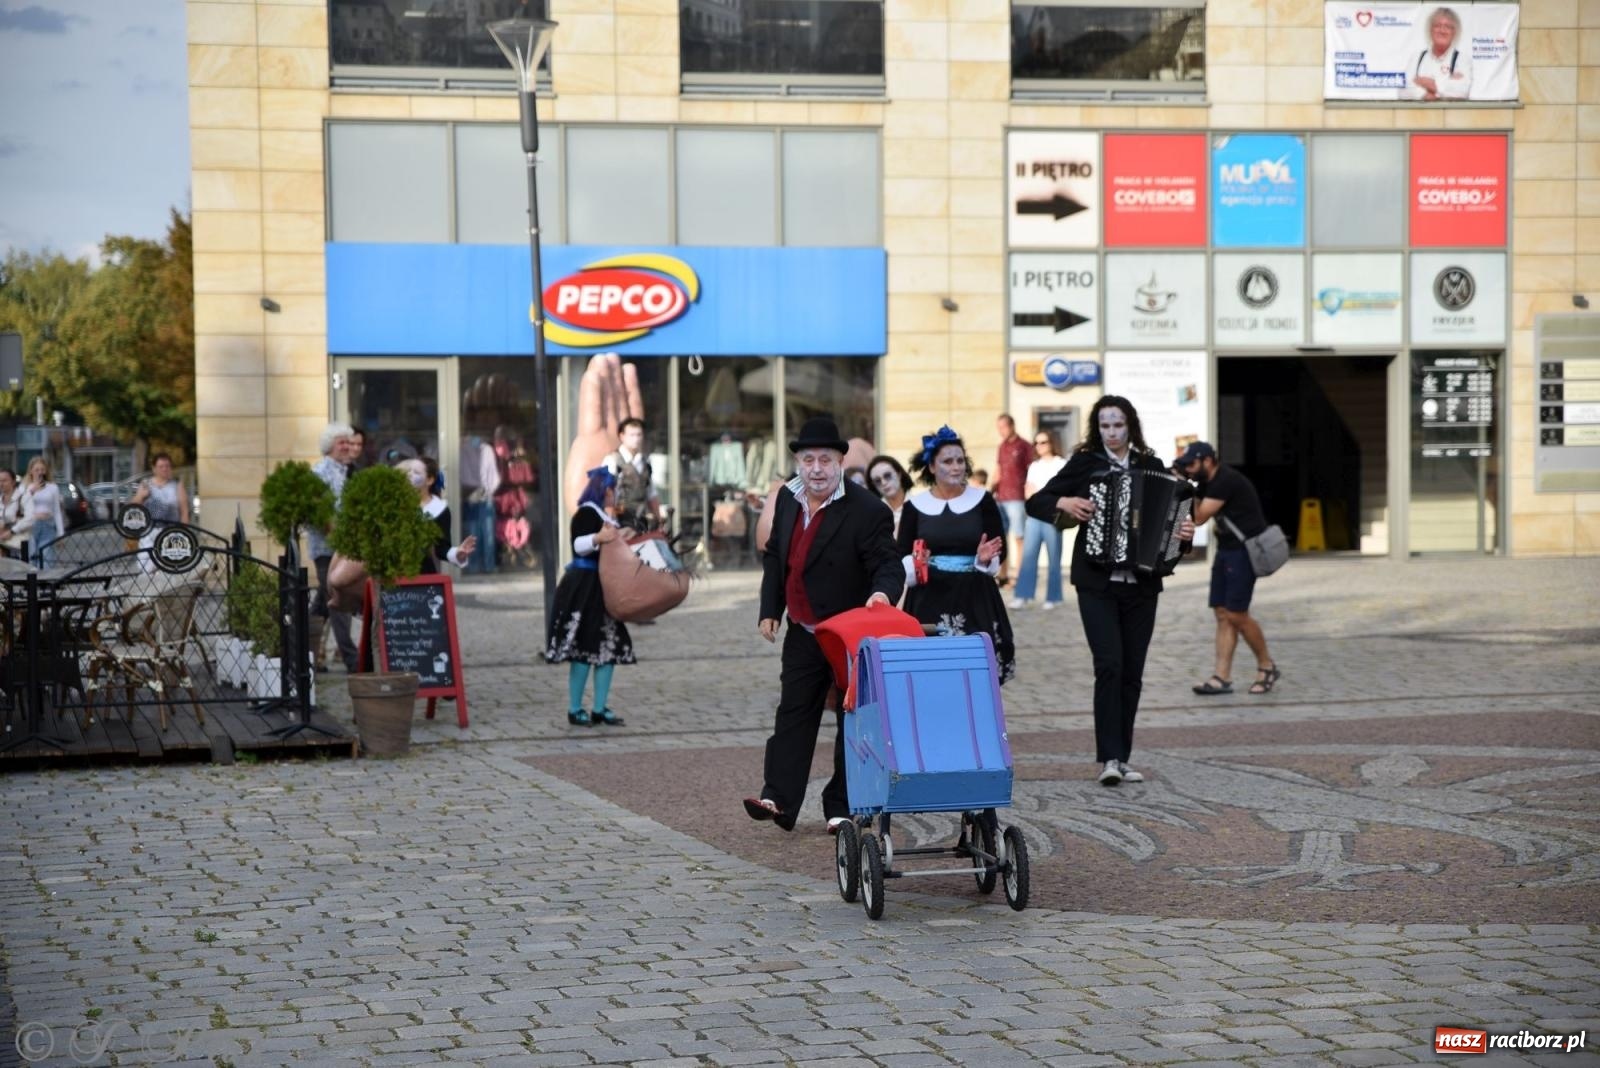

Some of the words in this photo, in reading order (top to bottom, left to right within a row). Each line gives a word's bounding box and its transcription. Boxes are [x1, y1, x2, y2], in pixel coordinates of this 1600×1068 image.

[1016, 162, 1026, 178] II
[1031, 162, 1093, 182] PIĘTRO
[1113, 188, 1178, 206] COVEBO
[1417, 188, 1481, 205] COVEBO
[1013, 271, 1018, 288] I
[1025, 271, 1094, 292] PIĘTRO
[556, 284, 673, 315] PEPCO
